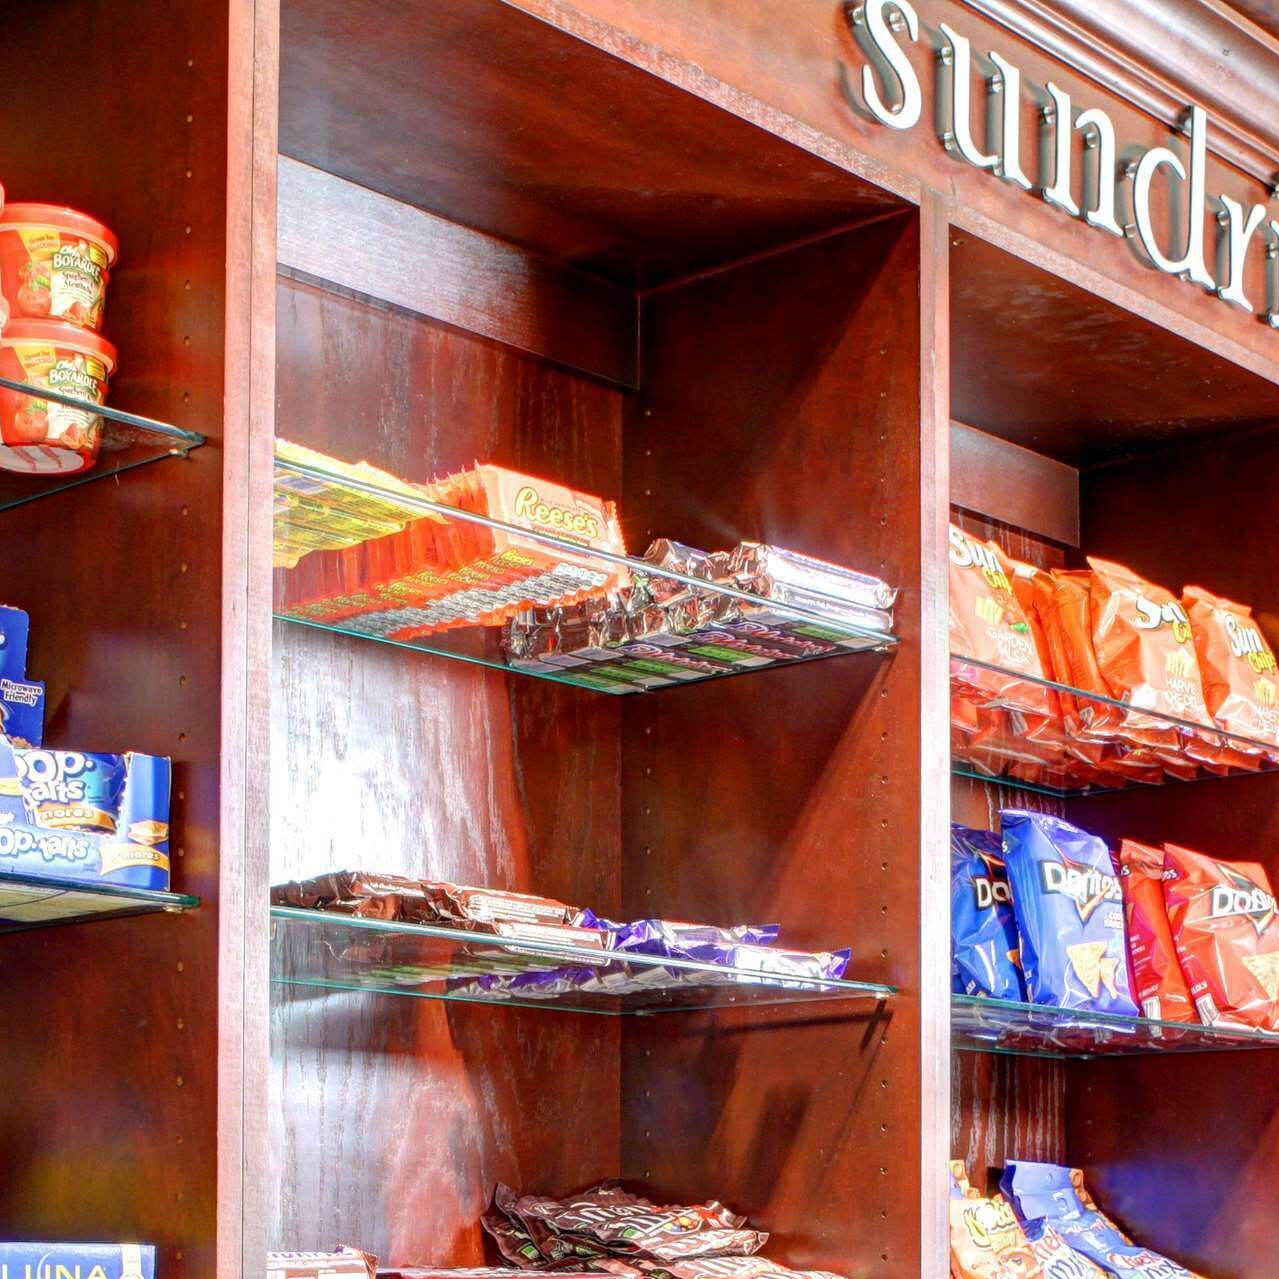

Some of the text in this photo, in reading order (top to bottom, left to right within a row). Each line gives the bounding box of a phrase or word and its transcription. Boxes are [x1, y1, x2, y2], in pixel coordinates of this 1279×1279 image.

[514, 486, 599, 538] Reese's
[0, 678, 43, 695] Microwave
[3, 690, 39, 706] Friendly
